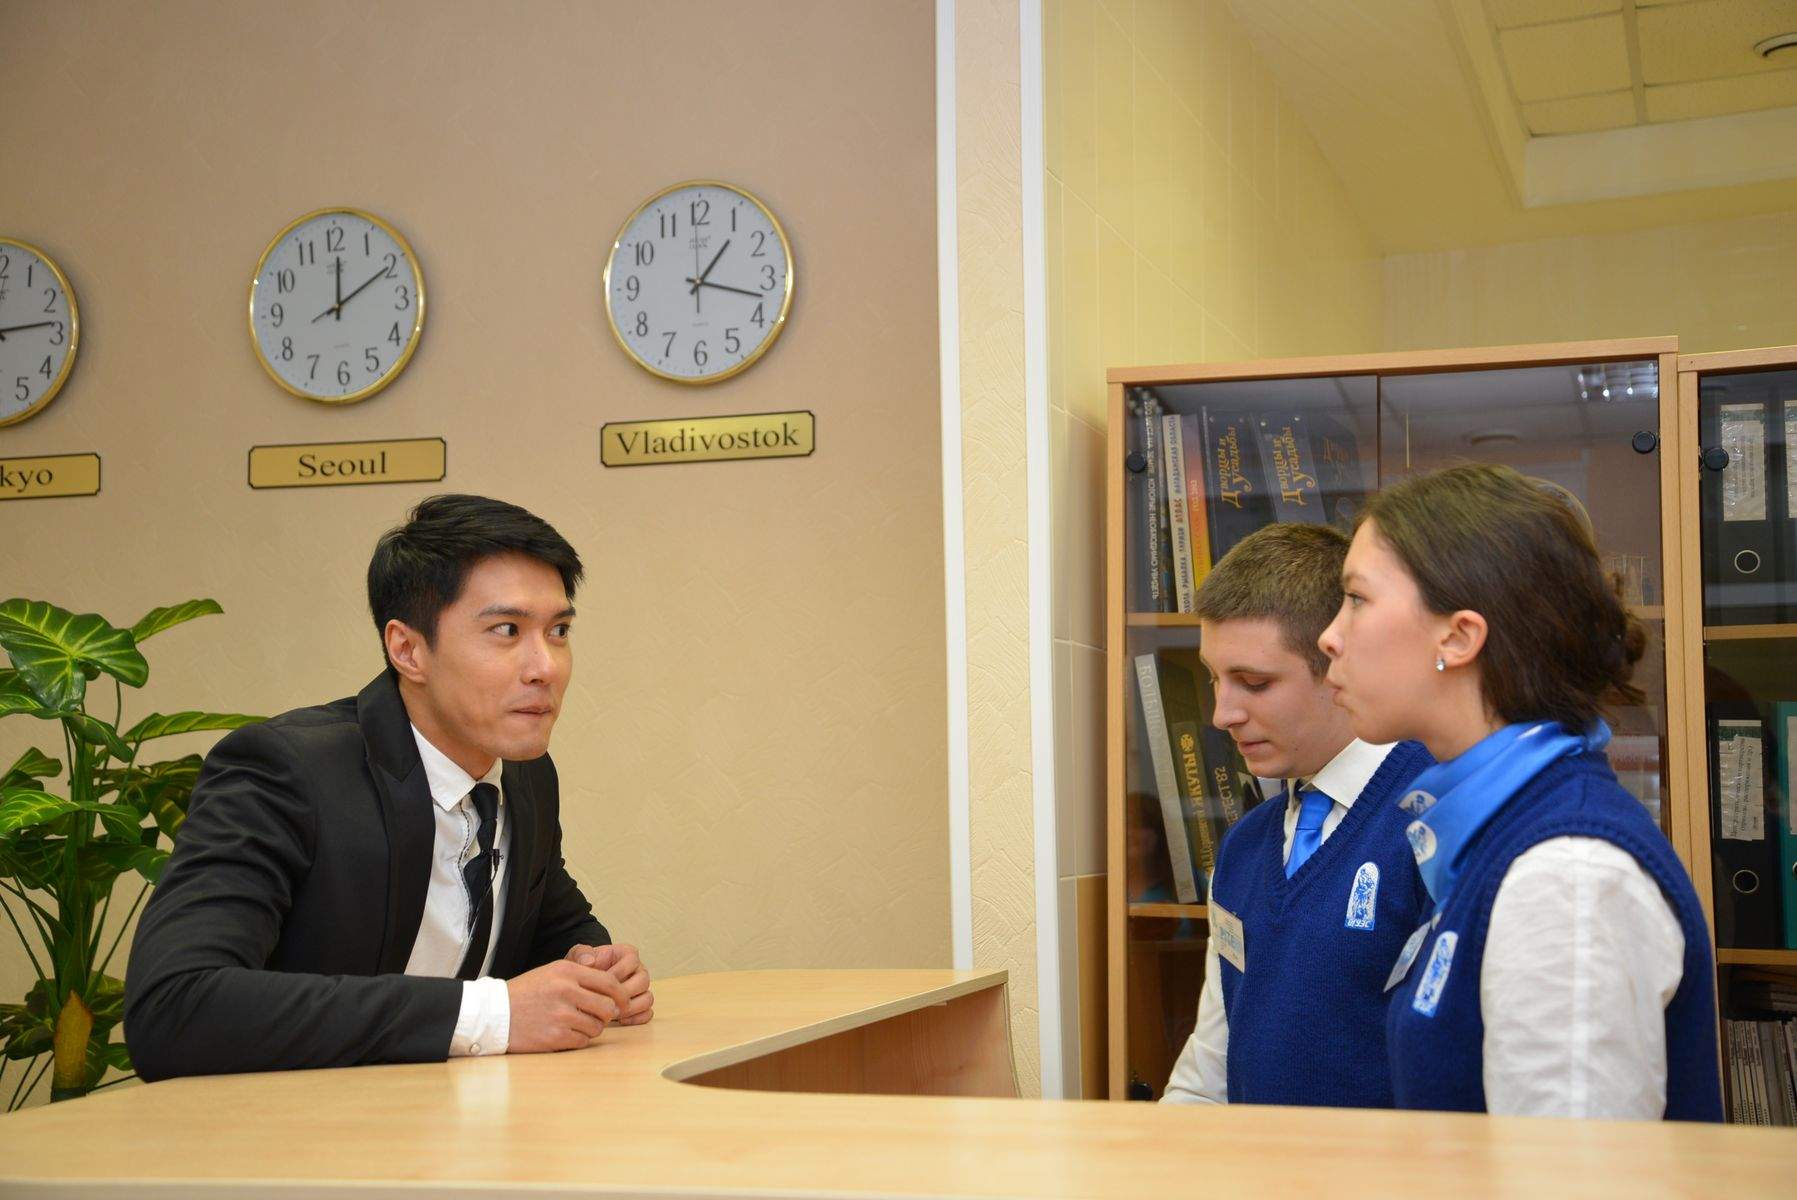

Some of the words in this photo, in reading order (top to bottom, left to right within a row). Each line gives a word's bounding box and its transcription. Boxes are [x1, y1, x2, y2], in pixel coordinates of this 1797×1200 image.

[660, 213, 676, 238] 11
[690, 200, 710, 226] 12
[731, 207, 736, 232] 1
[326, 226, 345, 253] 12
[364, 232, 370, 256] 1
[750, 230, 765, 257] 2
[299, 240, 315, 266] 11
[383, 253, 399, 278] 2
[635, 240, 654, 266] 10
[27, 264, 33, 288] 1
[277, 268, 295, 294] 10
[626, 275, 640, 302] 9
[760, 264, 776, 291] 3
[43, 288, 57, 314] 2
[394, 286, 410, 311] 3
[270, 302, 284, 328] 9
[636, 311, 648, 337] 8
[750, 302, 765, 328] 4
[49, 322, 64, 346] 3
[388, 322, 401, 346] 4
[662, 332, 677, 358] 7
[725, 328, 740, 354] 5
[282, 336, 294, 361] 8
[365, 347, 380, 372] 5
[694, 340, 708, 366] 6
[39, 355, 52, 379] 4
[307, 354, 320, 380] 7
[338, 360, 350, 386] 6
[15, 376, 30, 400] 5
[616, 422, 800, 455] Vladivostok
[298, 451, 388, 478] Seoul
[1273, 450, 1308, 505] Дворцы
[1218, 448, 1243, 508] Дворцы
